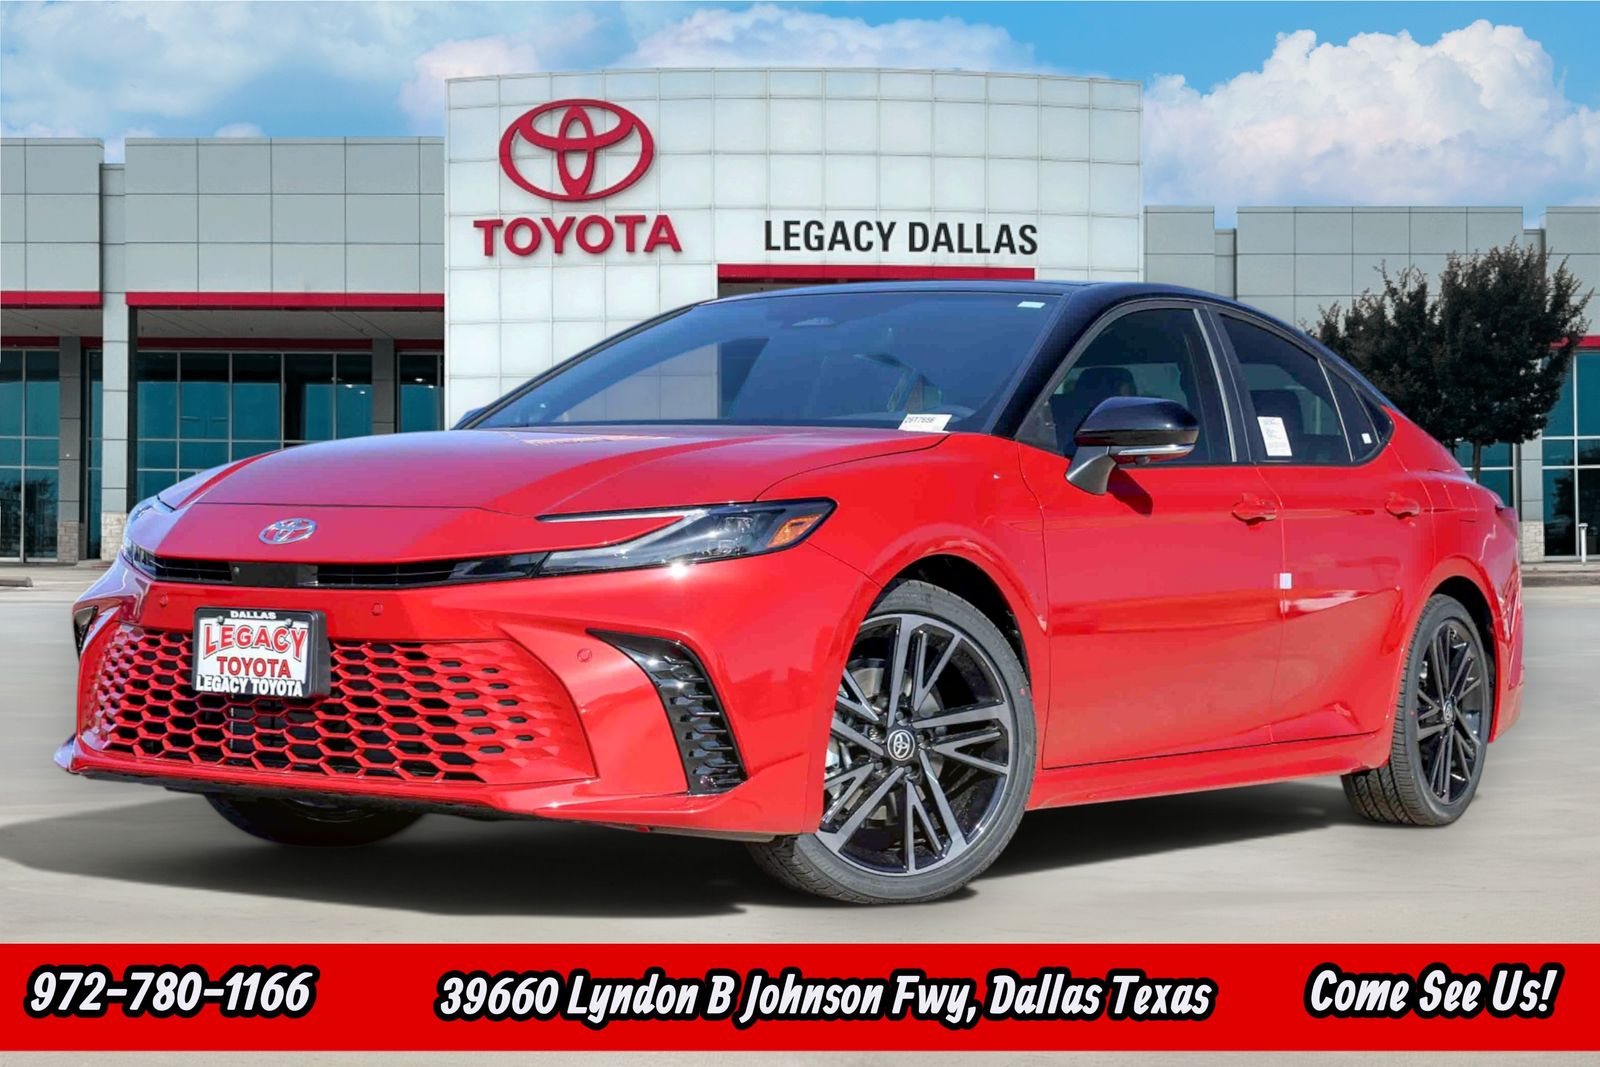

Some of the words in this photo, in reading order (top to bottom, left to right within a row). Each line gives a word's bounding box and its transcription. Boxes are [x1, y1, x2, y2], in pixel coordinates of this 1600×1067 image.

[473, 214, 683, 257] TOYOTA
[764, 219, 897, 252] LEGACY
[908, 221, 1039, 255] DALLAS
[230, 610, 277, 620] DALLAS
[203, 623, 308, 662] LEGACY
[216, 656, 292, 679] TOYOTA
[195, 674, 249, 694] LEGACY
[250, 676, 303, 697] TOYOTA
